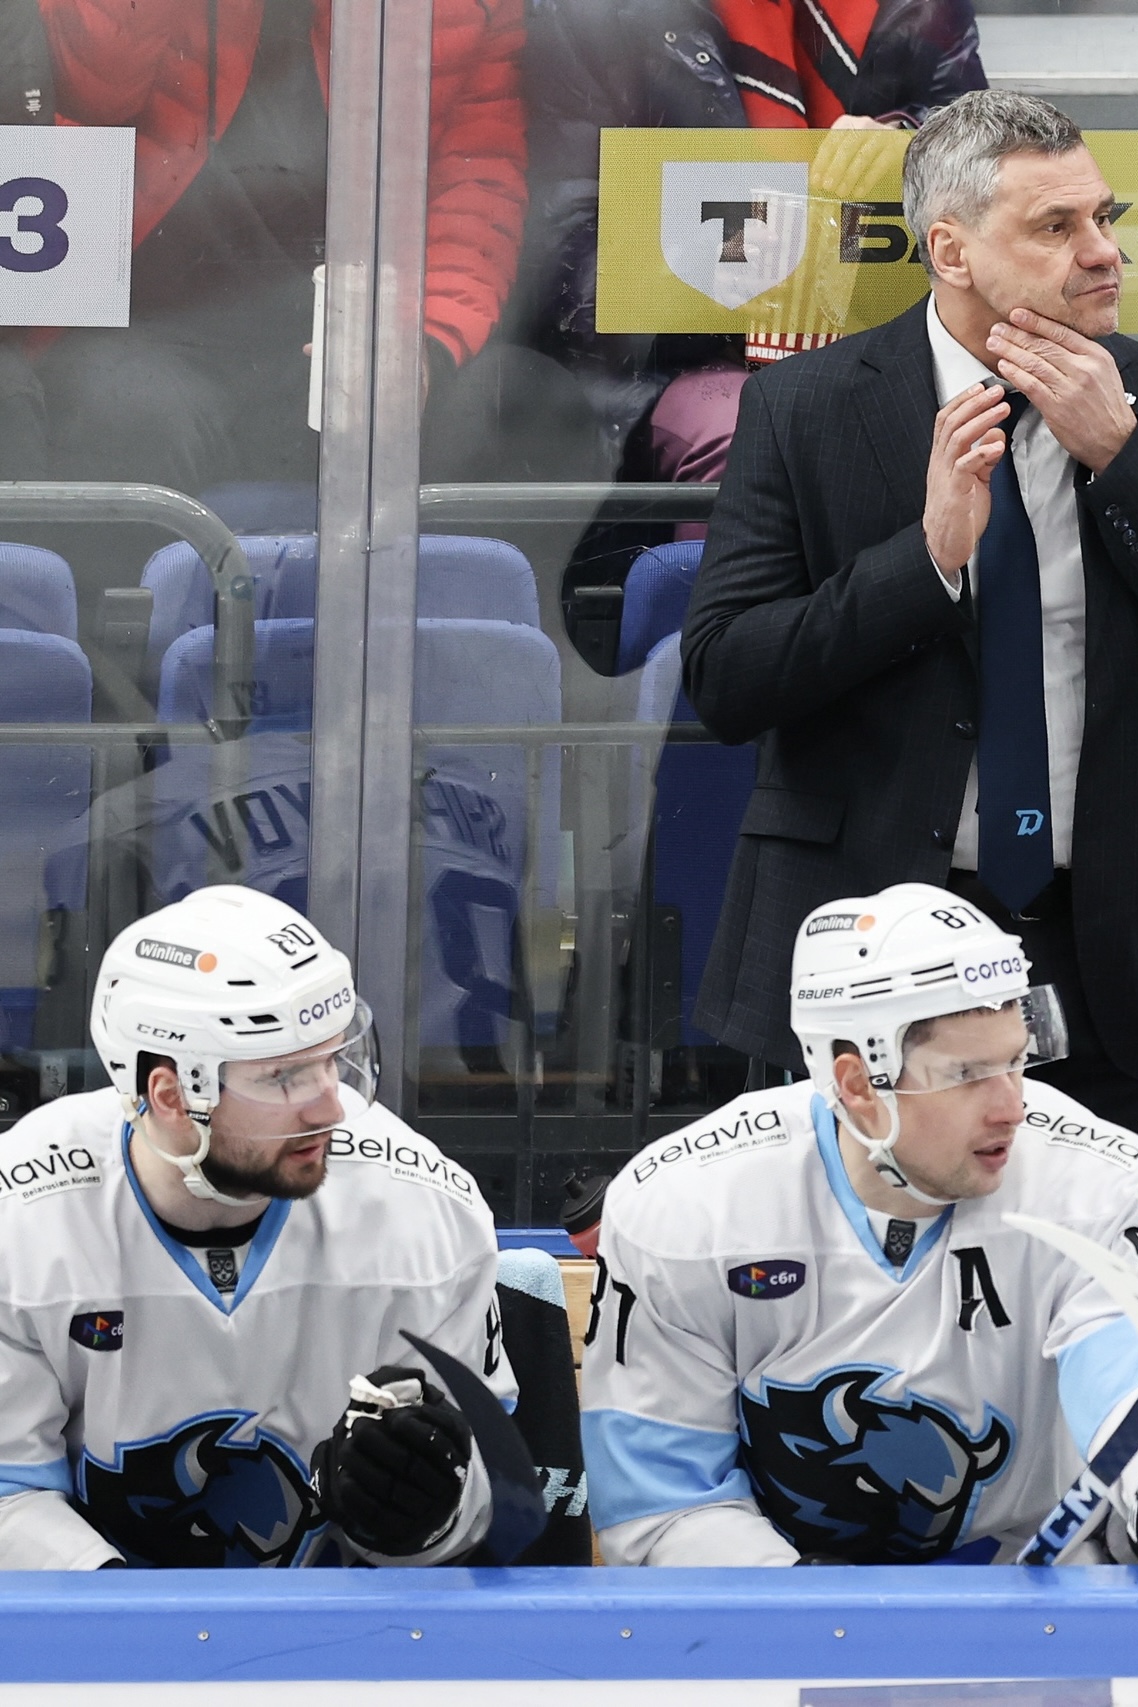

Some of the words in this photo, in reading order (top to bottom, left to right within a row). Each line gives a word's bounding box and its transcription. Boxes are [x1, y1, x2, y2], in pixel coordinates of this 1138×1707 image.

[809, 918, 853, 934] Winline
[931, 905, 981, 929] 87
[139, 941, 193, 966] Winline
[964, 957, 1023, 983] согаз
[797, 987, 844, 1000] BAUER
[299, 987, 351, 1026] согаз
[137, 1023, 187, 1042] CCM
[633, 1110, 781, 1184] Belavia
[751, 1133, 787, 1146] Airlines
[329, 1128, 472, 1195] Belavia
[22, 1180, 70, 1199] Belarusian
[769, 1271, 797, 1285] сбп
[950, 1246, 1012, 1331] A
